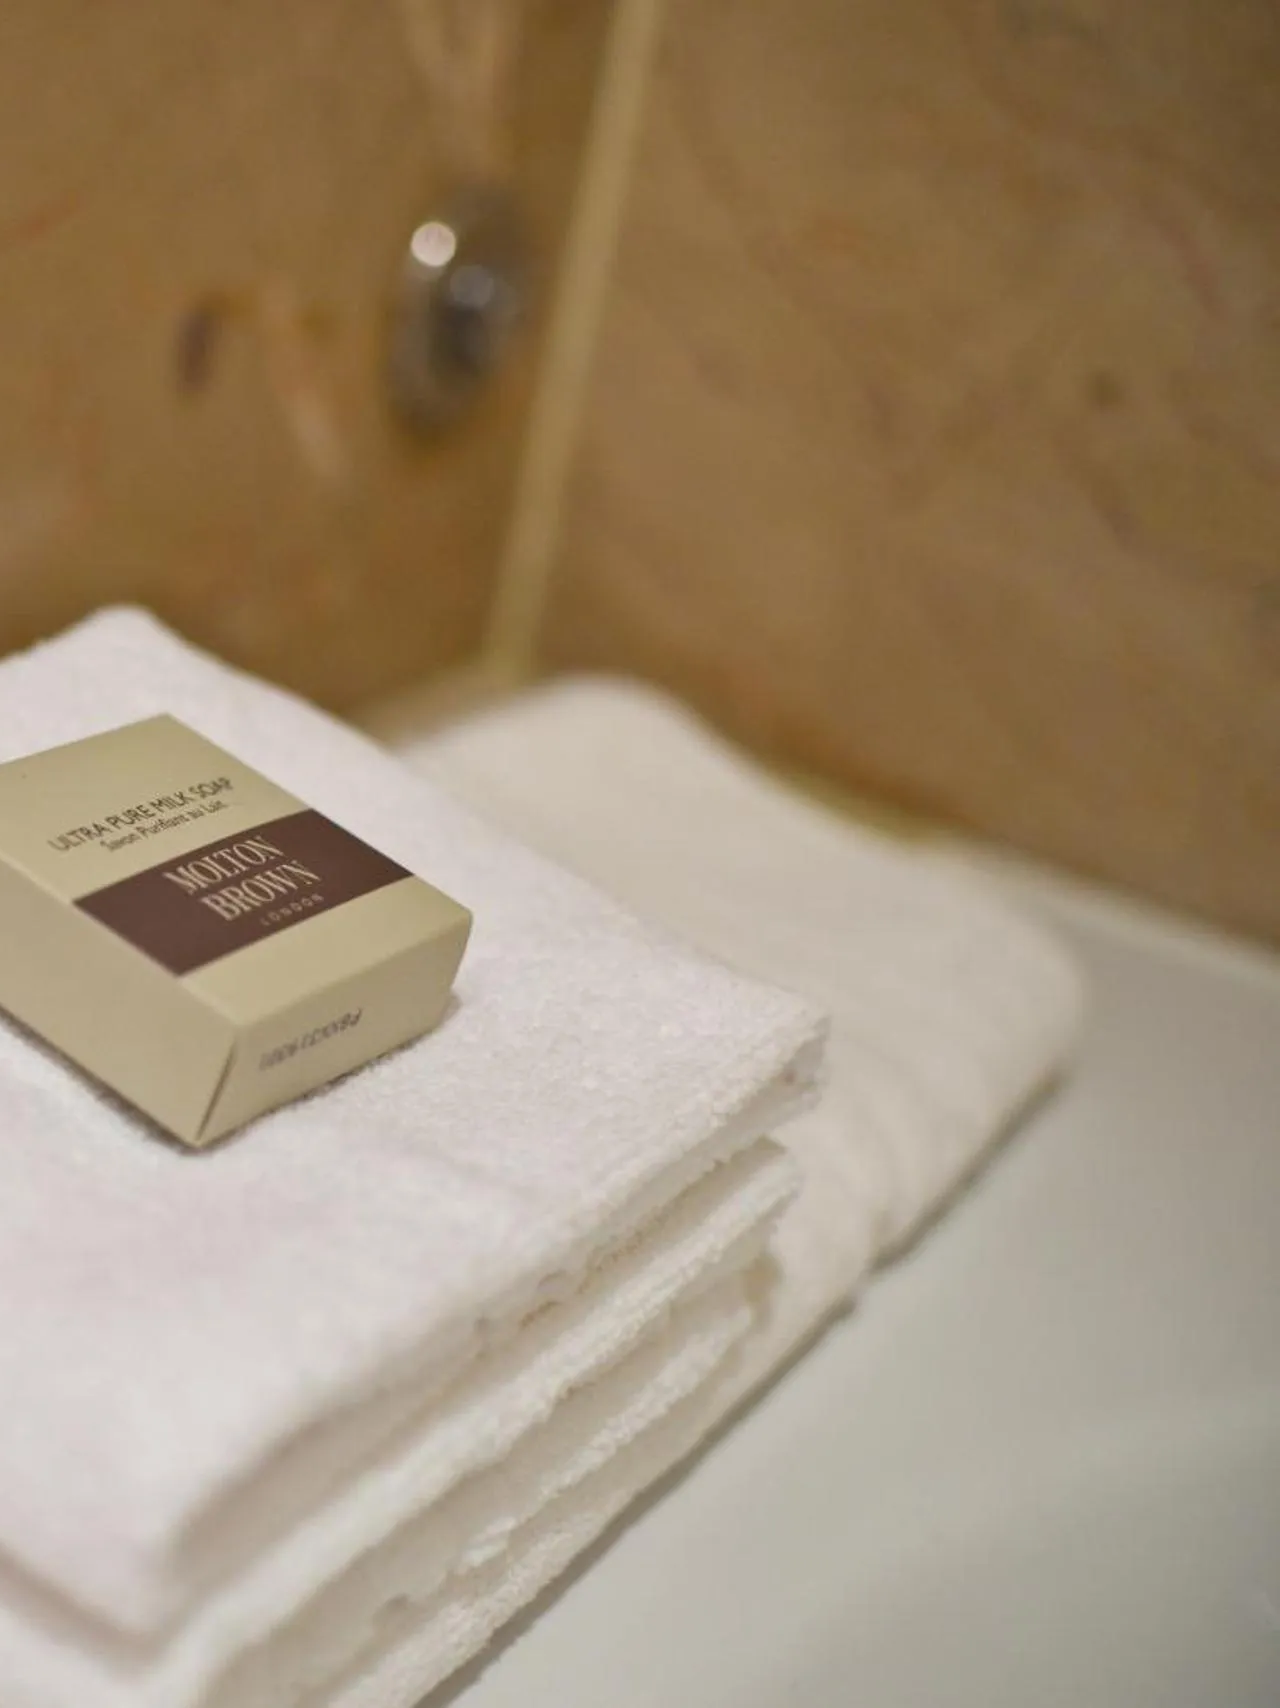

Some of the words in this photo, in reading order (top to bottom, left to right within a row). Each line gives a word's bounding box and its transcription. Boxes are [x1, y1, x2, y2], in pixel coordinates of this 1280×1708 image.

[47, 822, 113, 852] ULTRA
[105, 804, 155, 830] PURE
[150, 791, 195, 814] MILK
[188, 777, 233, 798] SOAP
[99, 832, 142, 852] Savon
[136, 814, 190, 839] Purifiant
[189, 806, 206, 819] au
[163, 835, 284, 895] MOLTON
[201, 859, 321, 922] BROWN
[261, 893, 324, 926] LONDON
